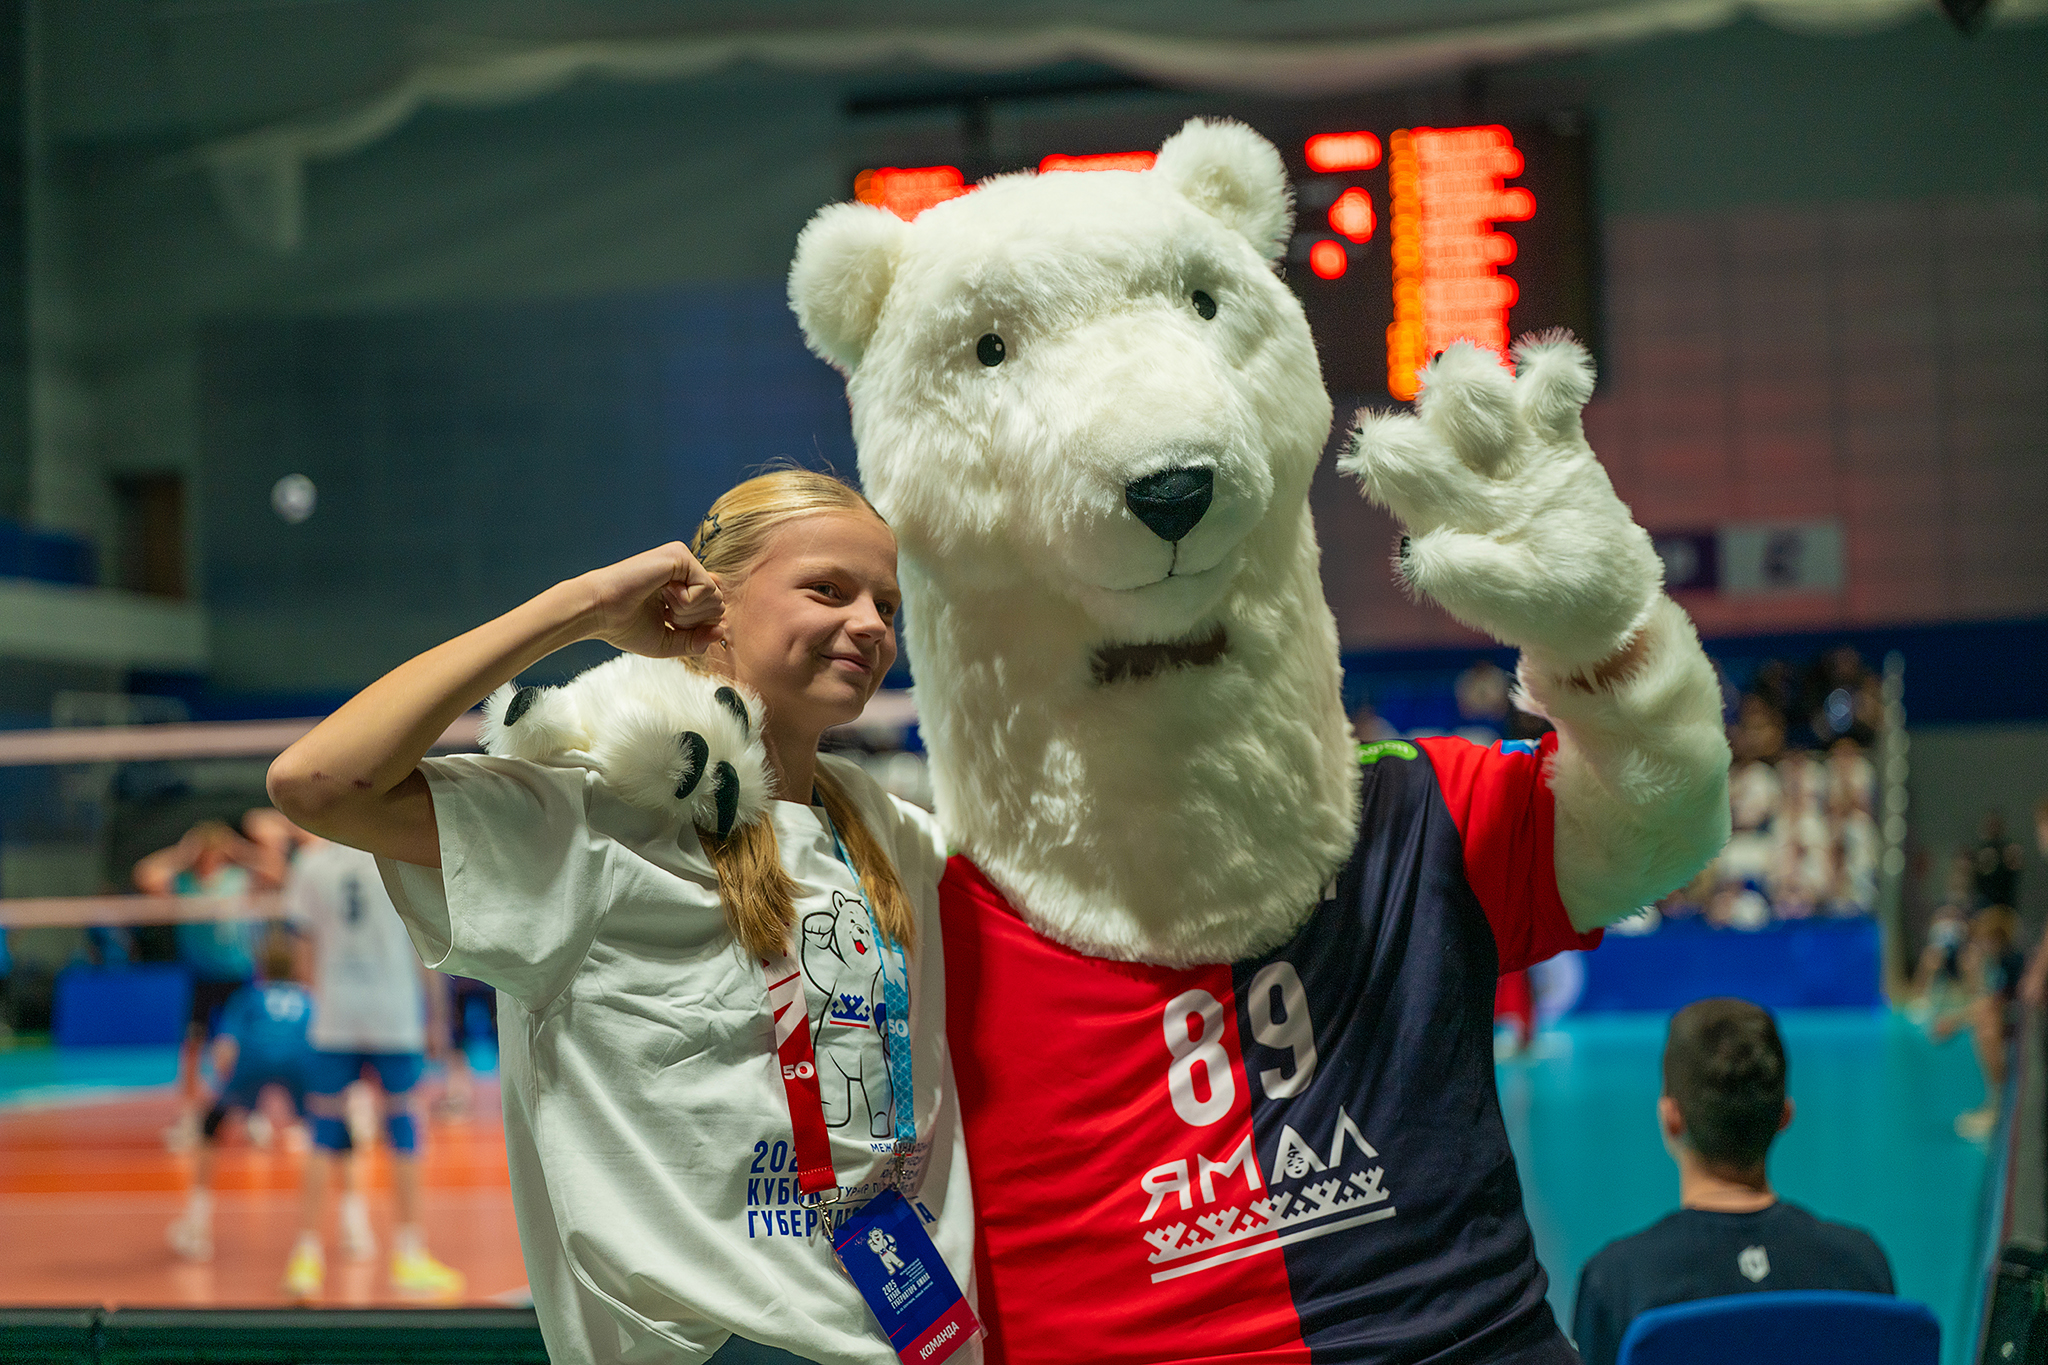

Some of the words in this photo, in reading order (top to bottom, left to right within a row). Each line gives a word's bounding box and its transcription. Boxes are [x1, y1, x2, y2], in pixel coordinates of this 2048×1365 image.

[888, 1019, 908, 1038] 50
[1163, 960, 1318, 1127] 89
[782, 1061, 815, 1080] 50
[1139, 1104, 1379, 1223] ЯМАЛ
[882, 1279, 897, 1296] 2025
[919, 1321, 960, 1360] КОМАНДА
